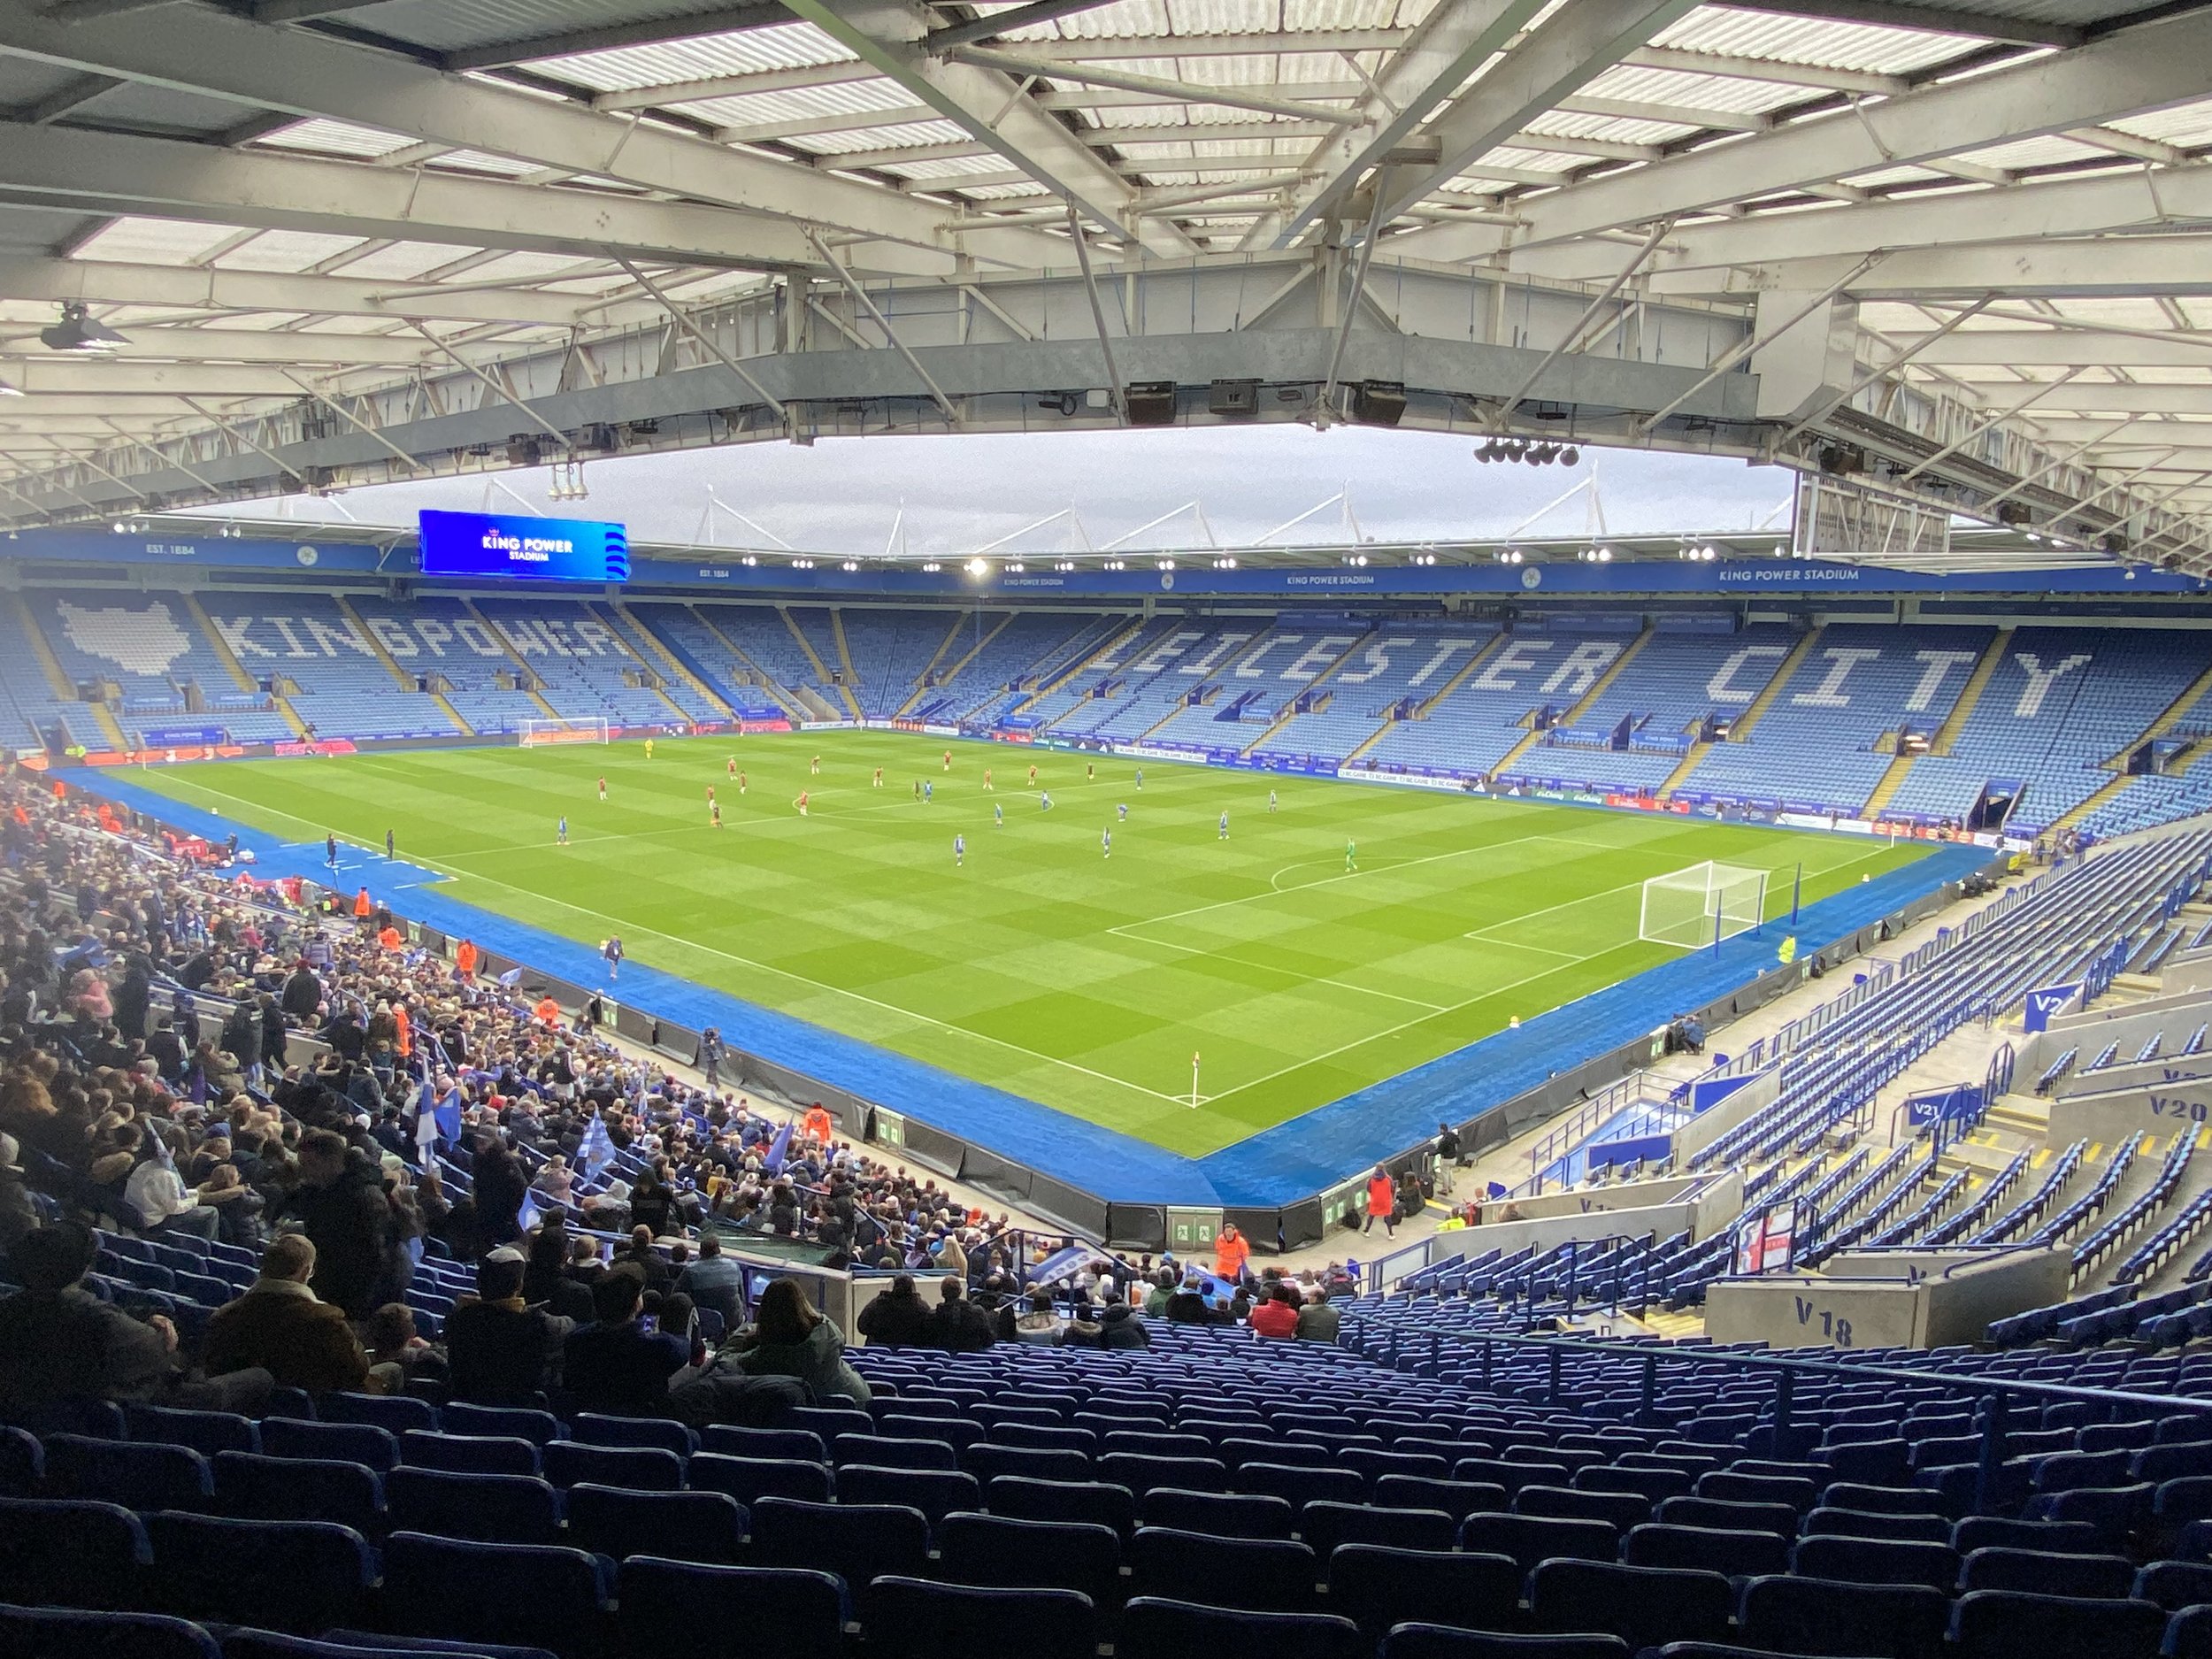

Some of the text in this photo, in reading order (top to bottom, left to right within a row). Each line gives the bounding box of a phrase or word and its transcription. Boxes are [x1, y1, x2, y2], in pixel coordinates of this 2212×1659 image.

[146, 544, 167, 554] EST.
[482, 535, 573, 553] KING POWER
[509, 550, 549, 561] STADIUM
[1340, 575, 1374, 584] STADIUM
[1719, 569, 1859, 581] KING POWER STADIUM
[1088, 632, 2093, 717] LEICESTER CITY
[1914, 1102, 1939, 1116] V21
[2150, 1095, 2207, 1122] V20
[1795, 1295, 1852, 1347] V18
